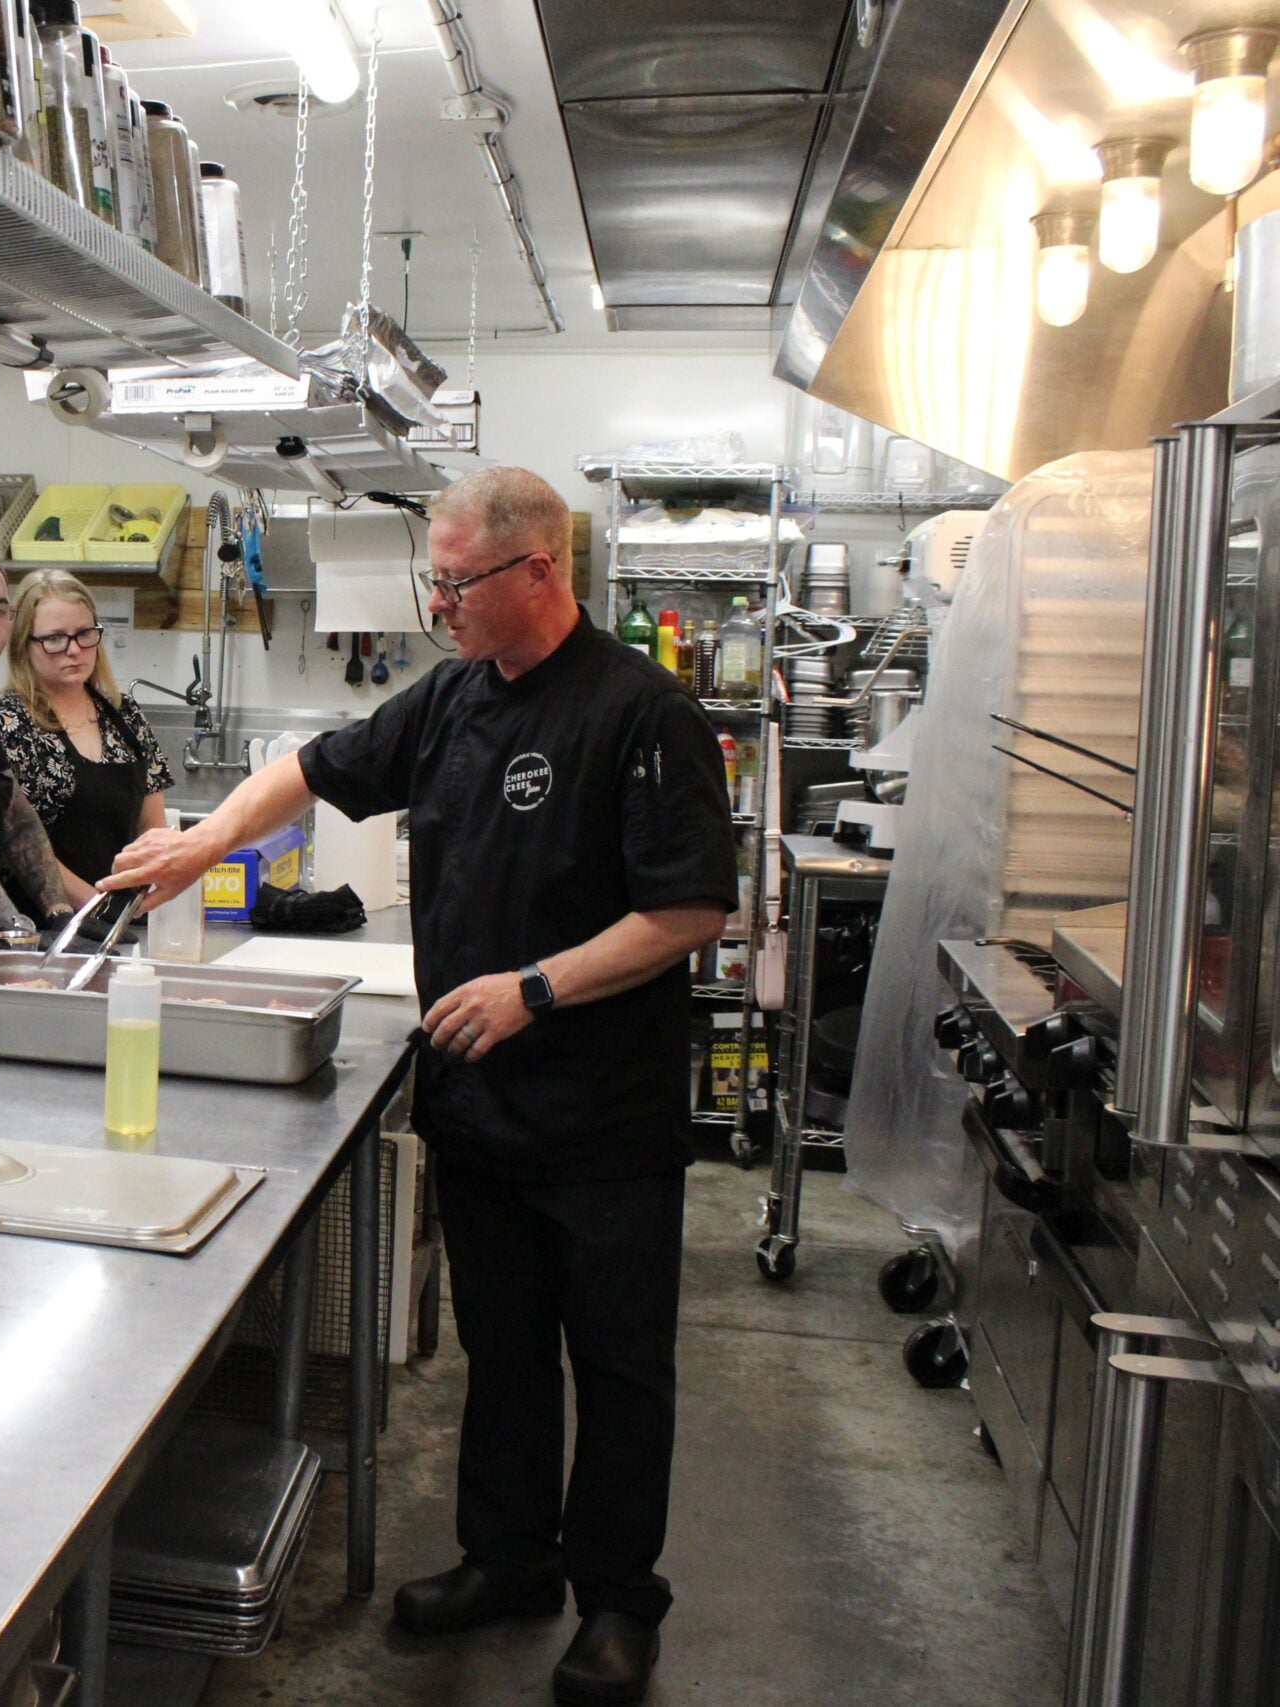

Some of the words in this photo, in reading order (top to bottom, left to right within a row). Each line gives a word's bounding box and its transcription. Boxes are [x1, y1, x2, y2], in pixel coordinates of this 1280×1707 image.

[166, 387, 192, 395] ProPak
[506, 767, 549, 784] CHEROKEE
[506, 780, 531, 792] CREEK
